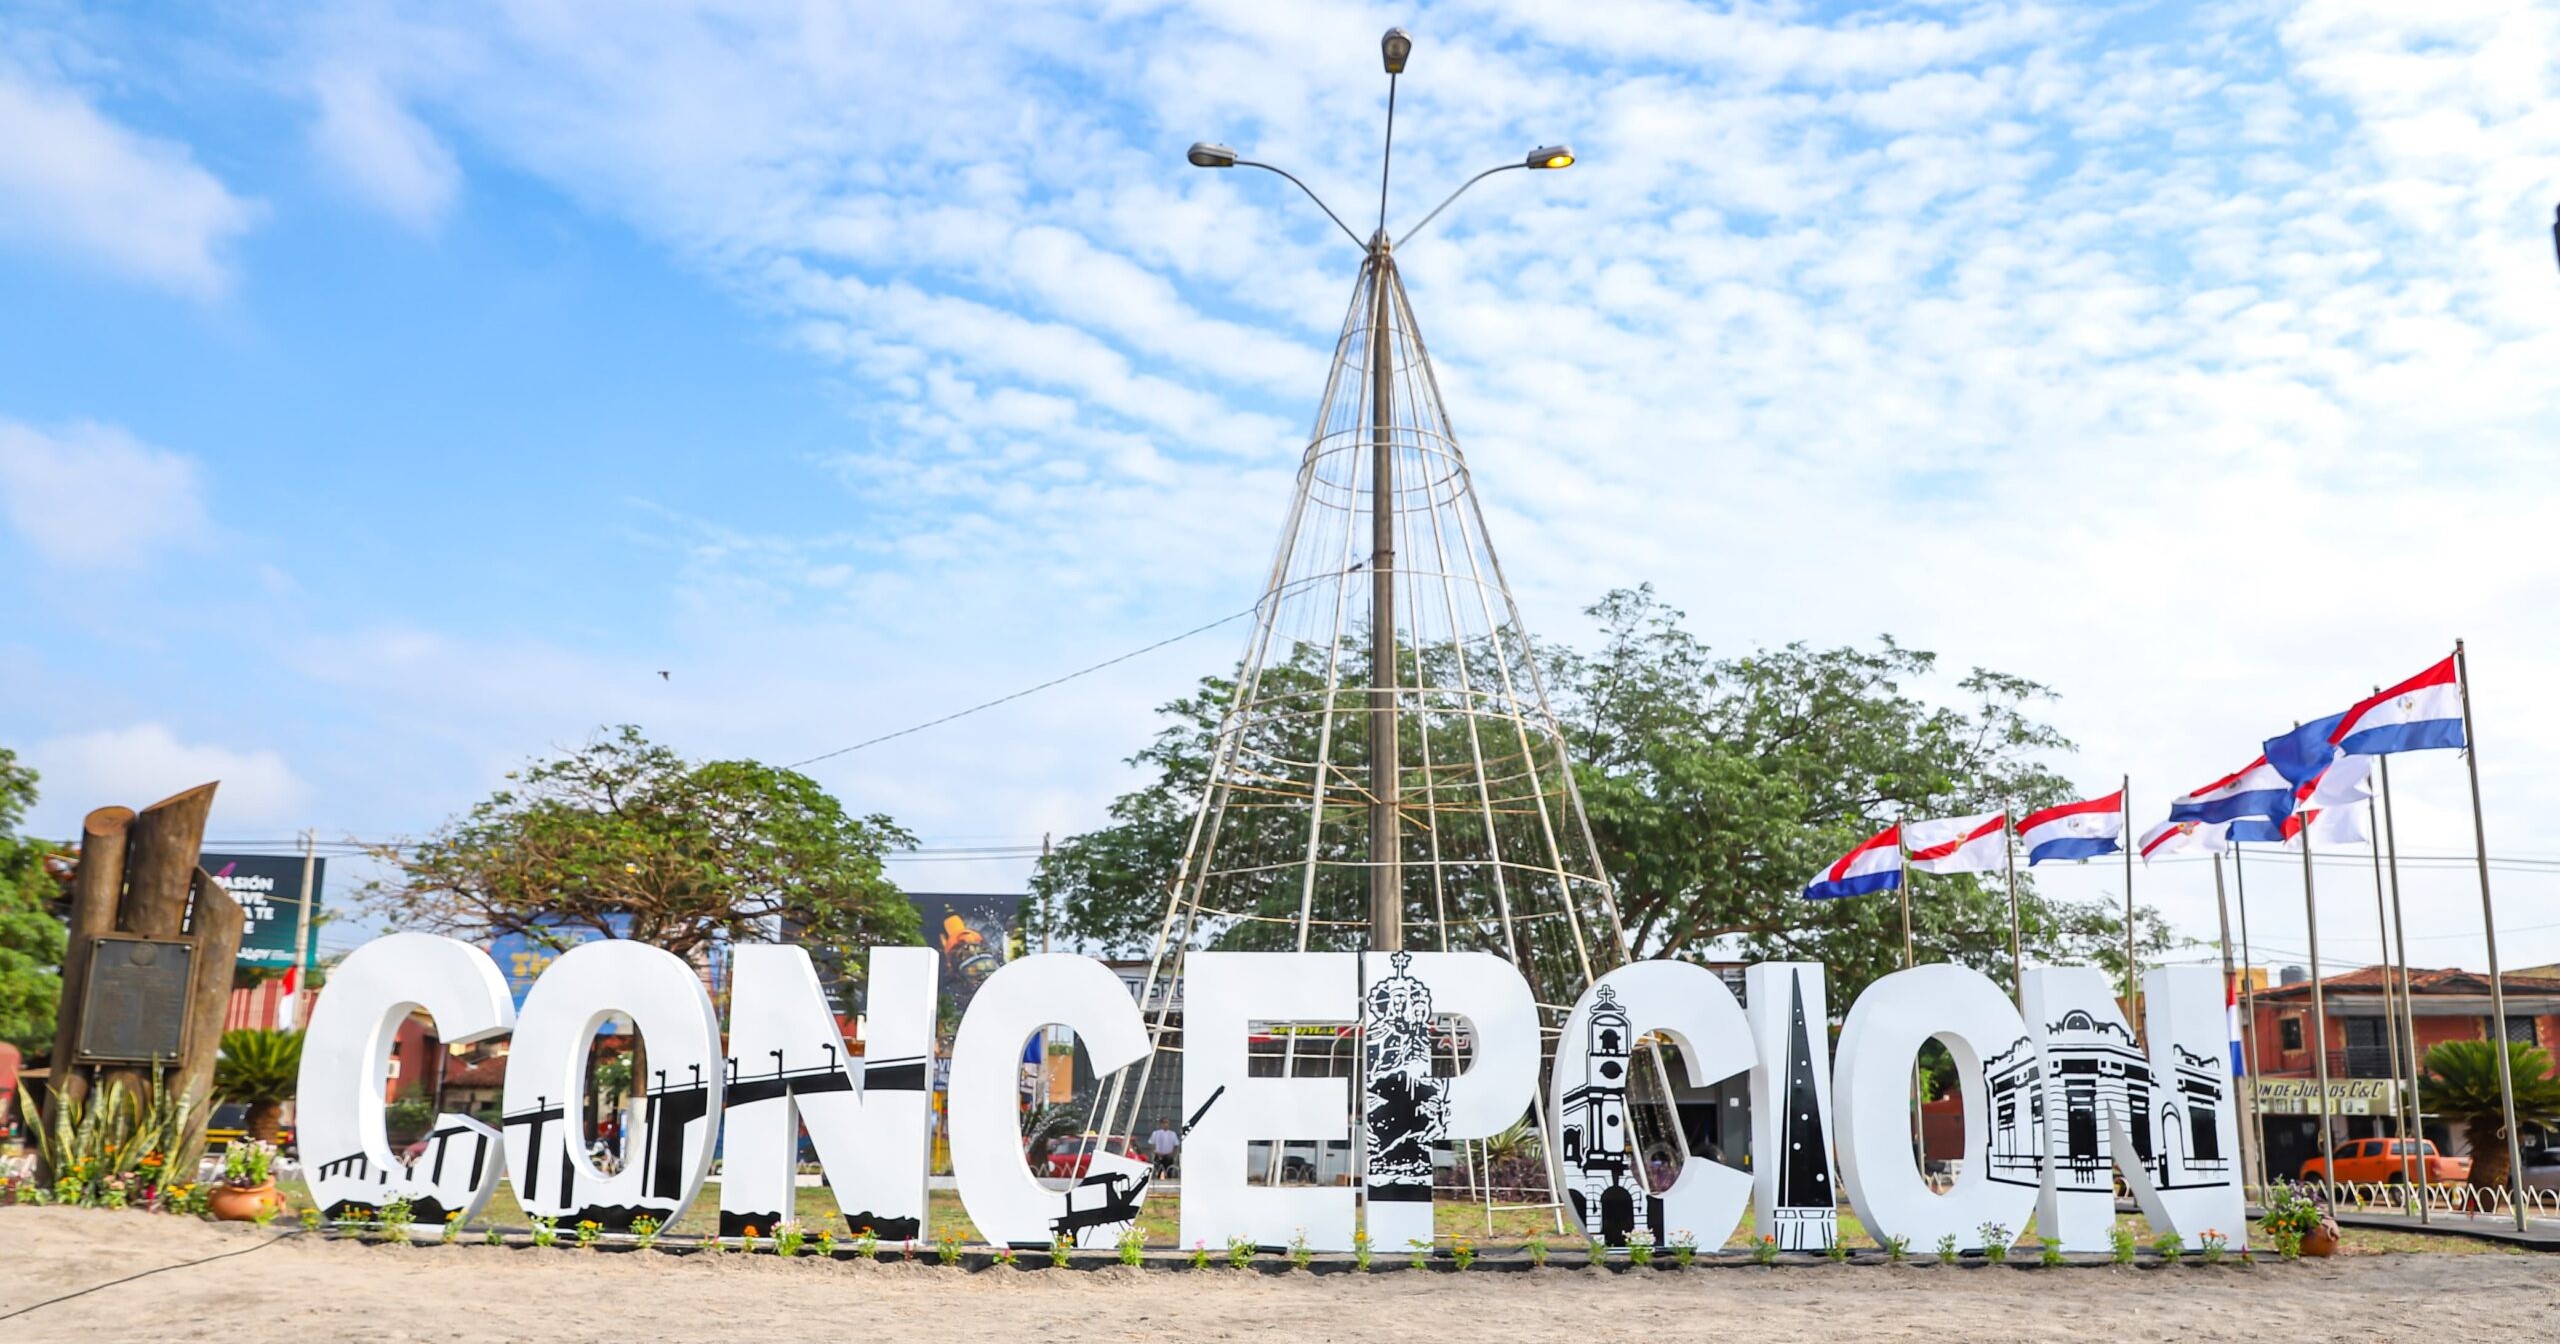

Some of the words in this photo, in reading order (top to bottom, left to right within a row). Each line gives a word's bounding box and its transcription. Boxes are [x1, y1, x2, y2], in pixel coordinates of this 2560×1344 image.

[254, 907, 275, 920] TE
[1270, 1026, 1336, 1035] GODYEAR
[297, 933, 2248, 1254] CONCEPCION
[2293, 1080, 2346, 1097] JUEOS
